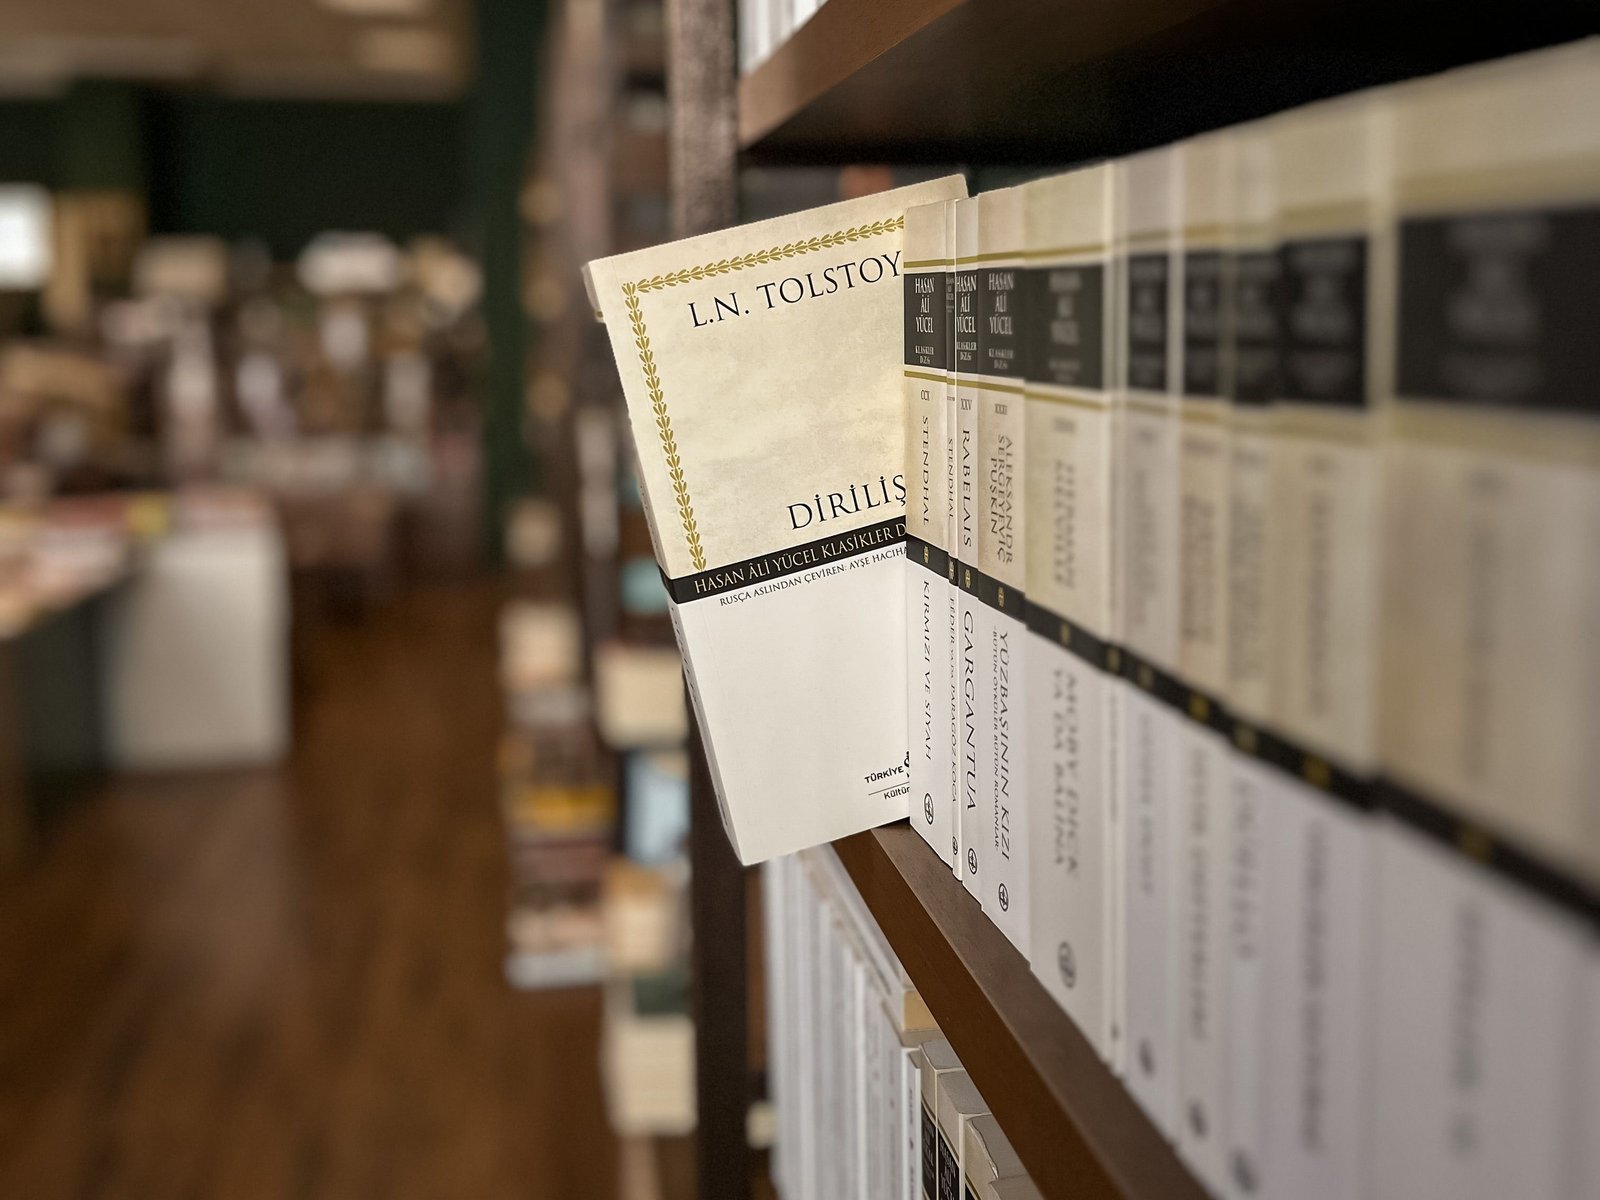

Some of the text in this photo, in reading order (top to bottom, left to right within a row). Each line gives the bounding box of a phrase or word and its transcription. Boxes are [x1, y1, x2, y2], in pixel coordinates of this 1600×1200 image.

[688, 250, 902, 328] L.N. TOLSTOY
[914, 277, 935, 294] HASAN
[956, 274, 977, 292] HASAN
[988, 272, 1015, 291] HASAN
[915, 314, 934, 334] YÜCEL
[922, 415, 930, 526] STENDHAL
[962, 429, 972, 548] RABELAIS
[786, 474, 907, 531] DİRİLİŞ
[1005, 435, 1013, 566] ALEKSANDR
[694, 568, 745, 594] HASAN
[748, 558, 771, 580] ÂLİ
[772, 548, 820, 572] YÜCEL
[821, 527, 894, 559] KLASİKLER
[719, 592, 752, 607] RUSÇA
[753, 576, 802, 598] ASLINDAN
[803, 563, 847, 584] ÇEVİREN:
[849, 556, 870, 570] AYŞE
[923, 580, 931, 662] KIRMIZI
[924, 670, 932, 694] VE
[964, 610, 977, 811] GARGANTUA
[864, 765, 904, 783] TÜRKİYE
[999, 631, 1010, 861] YÜZBAŞININ KIZI
[883, 786, 910, 800] Kültür
